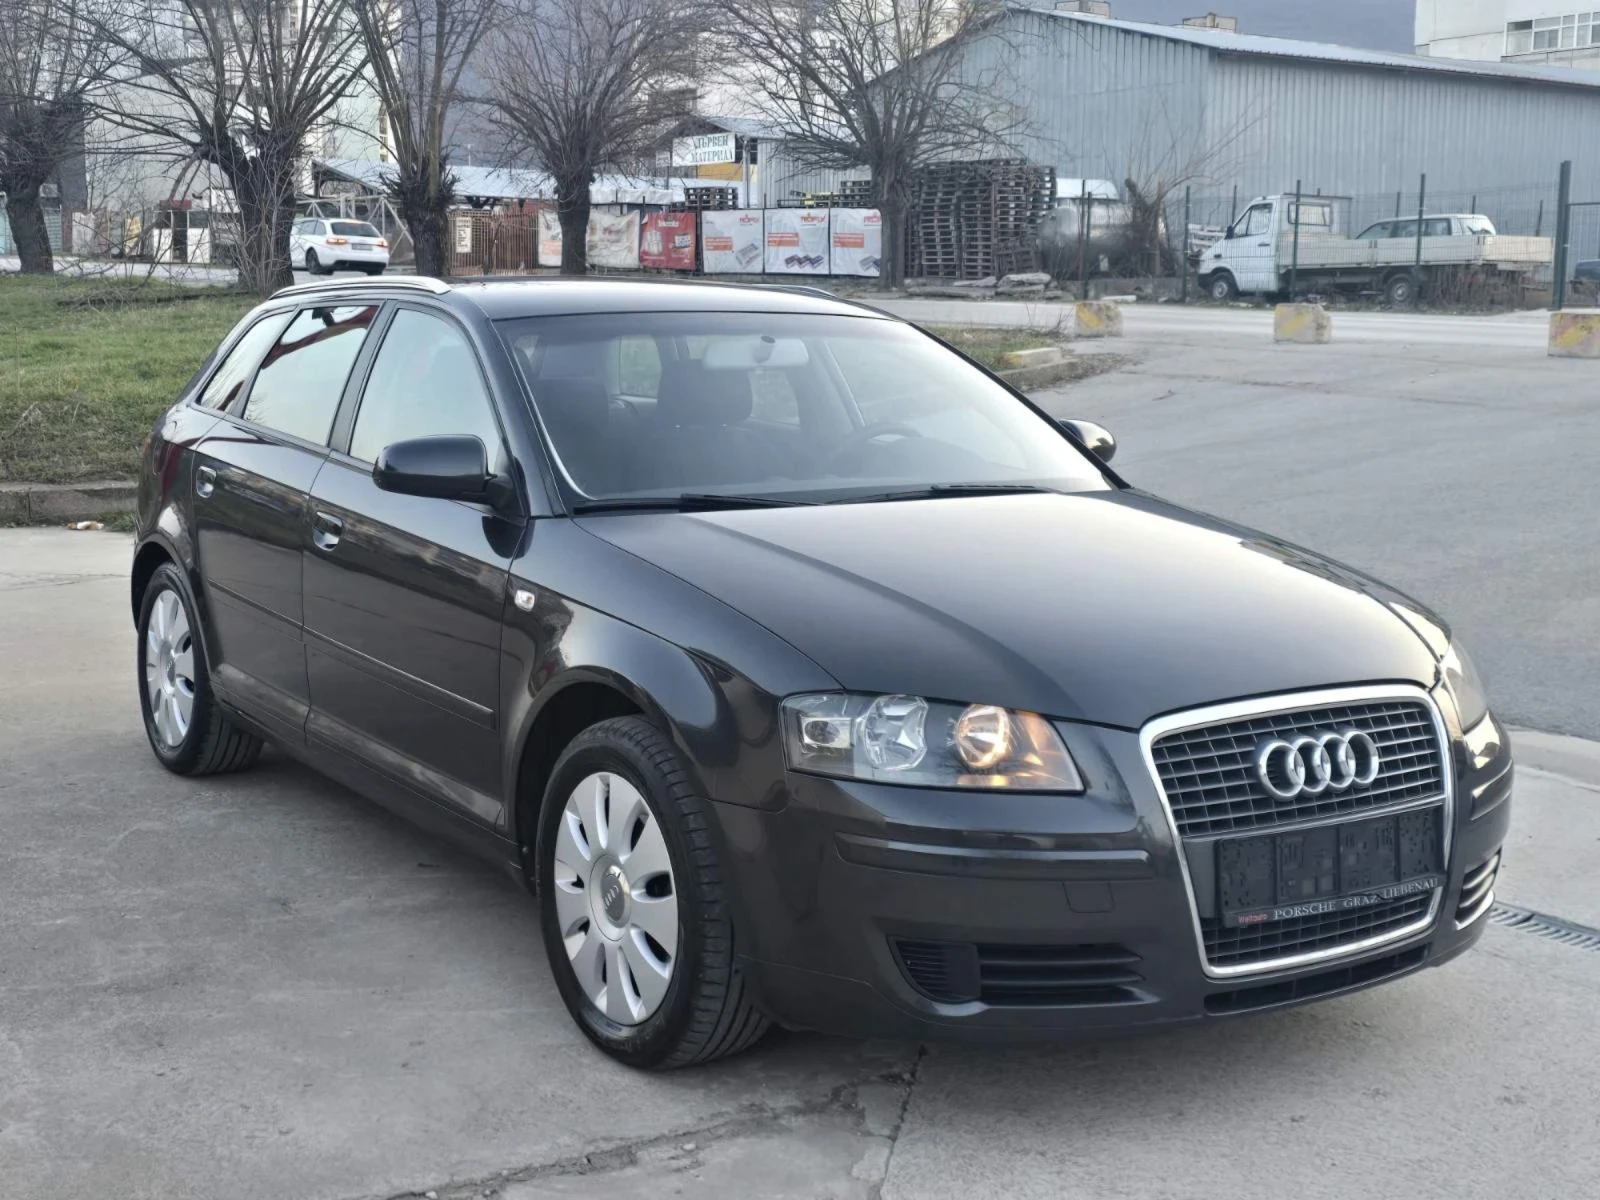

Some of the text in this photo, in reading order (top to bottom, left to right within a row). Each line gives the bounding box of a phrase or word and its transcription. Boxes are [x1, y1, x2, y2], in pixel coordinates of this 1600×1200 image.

[1273, 878, 1439, 921] PORSCHE GRAZ LIEBENAU
